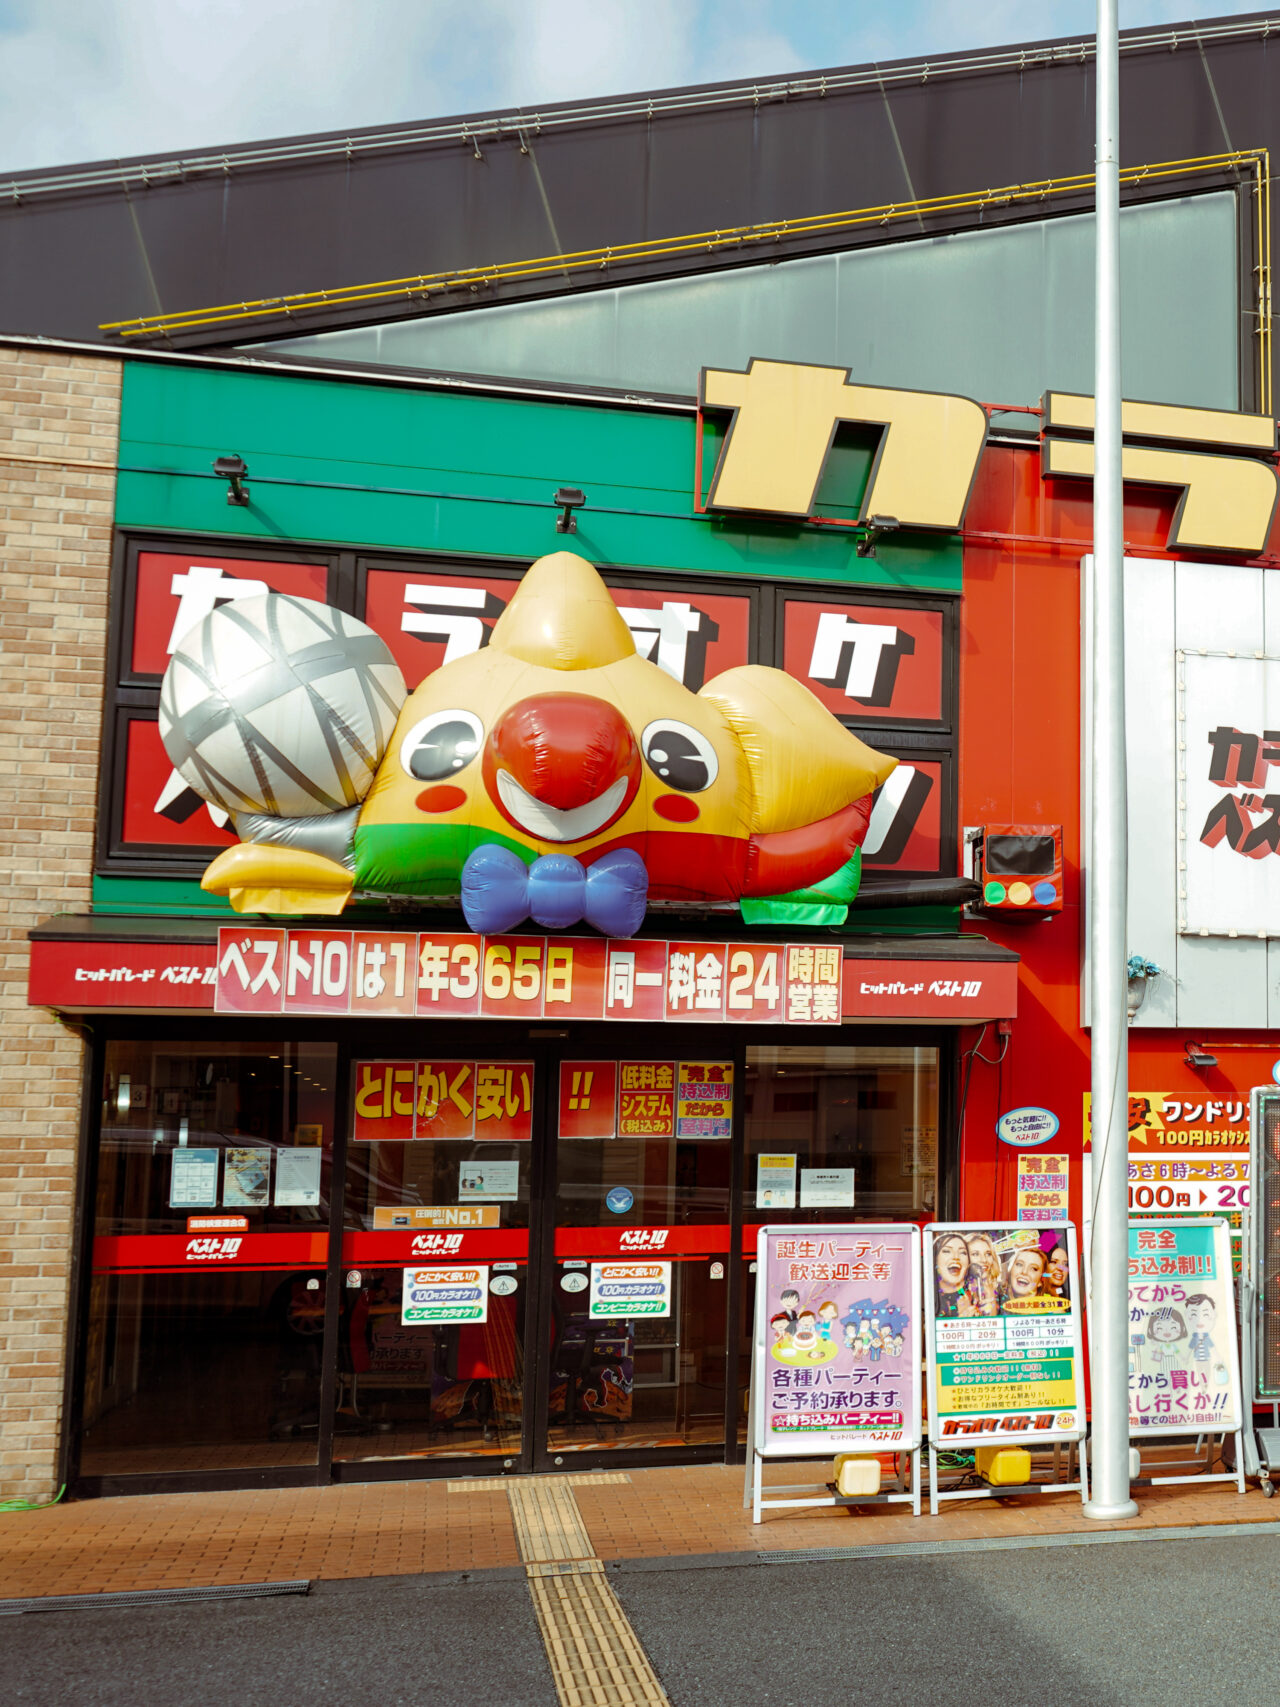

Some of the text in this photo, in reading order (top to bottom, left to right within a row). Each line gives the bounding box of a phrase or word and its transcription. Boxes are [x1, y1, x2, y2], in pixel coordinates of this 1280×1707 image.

[788, 947, 840, 985] 時間
[860, 980, 981, 998] ヒットパレード ベスト10
[788, 985, 839, 1021] 営業
[622, 1065, 673, 1089] 低料金
[356, 1066, 532, 1121] とにかく安い
[680, 1084, 730, 1099] 持込制
[622, 1095, 671, 1117] システム
[685, 1102, 724, 1116] だから
[621, 1119, 671, 1133] (税込み)
[1021, 1175, 1066, 1190] 持込制
[1025, 1193, 1061, 1206] だから
[446, 1209, 483, 1225] No.1
[186, 1238, 242, 1253] ベスト10
[411, 1234, 464, 1249] ベスト10
[619, 1230, 669, 1244] ベスト10
[1138, 1230, 1177, 1249] 完全
[777, 1241, 903, 1259] 誕生パーティー
[790, 1262, 891, 1281] 歓送迎会等
[1128, 1284, 1187, 1302] てから
[408, 1308, 479, 1319] コンビニカラオケ!!
[941, 1331, 997, 1340] 100円 20分
[1011, 1328, 1065, 1337] 100円 10分
[773, 1368, 902, 1388] 各種パーティー
[772, 1390, 903, 1410] ご予約承ります。
[1128, 1392, 1228, 1413] し行くか!!
[942, 1418, 1000, 1435] カラオケ
[1000, 1414, 1055, 1432] ベスト10
[869, 1431, 903, 1441] ベスト10
